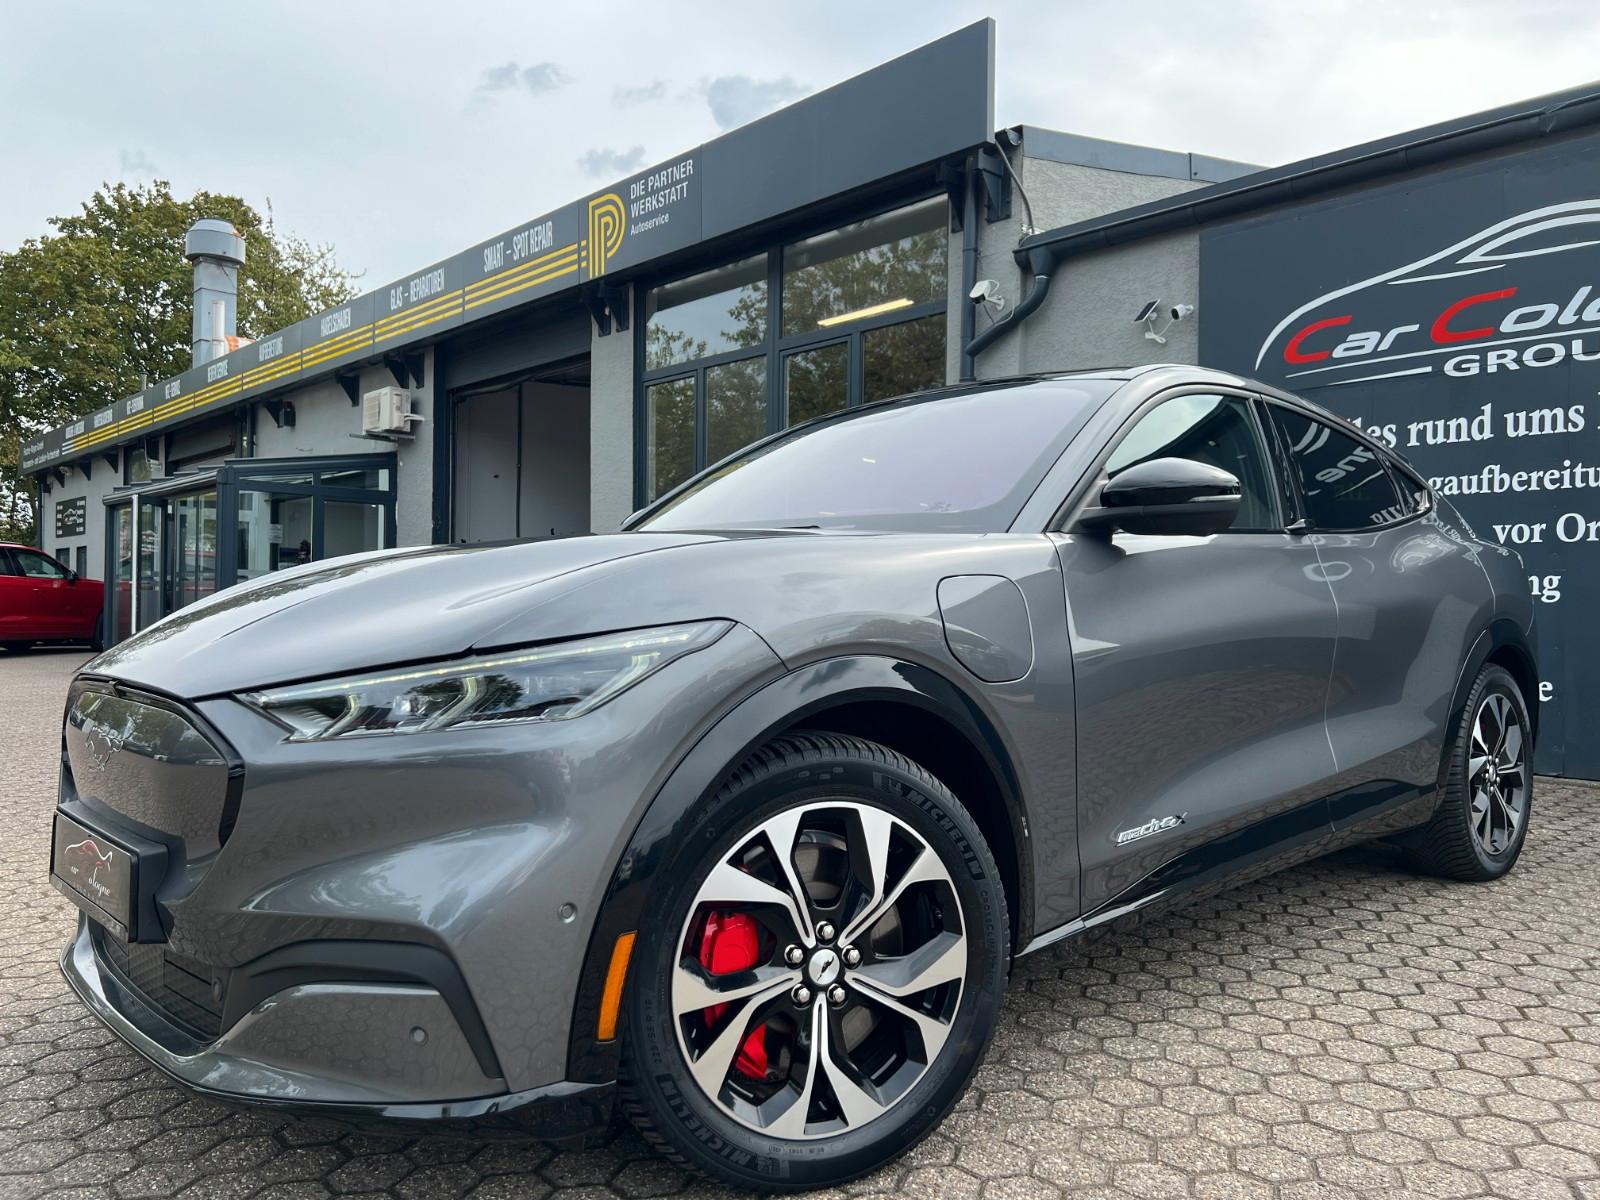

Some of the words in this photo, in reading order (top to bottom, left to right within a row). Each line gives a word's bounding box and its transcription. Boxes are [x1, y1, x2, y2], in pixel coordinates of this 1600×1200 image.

[630, 180, 646, 199] DIE
[648, 159, 694, 192] PARTNER
[630, 181, 689, 218] WERKSTATT
[483, 241, 505, 273] SMART
[512, 230, 529, 262] SPOT
[529, 220, 553, 255] REPAIR
[630, 212, 670, 236] Autoservice
[1283, 315, 1420, 365] Car
[1406, 402, 1495, 448] rund
[1503, 404, 1586, 438] ums
[1492, 522, 1547, 545] vor
[905, 789, 985, 877] MICHELIN
[660, 1077, 752, 1171] MICHELIN
